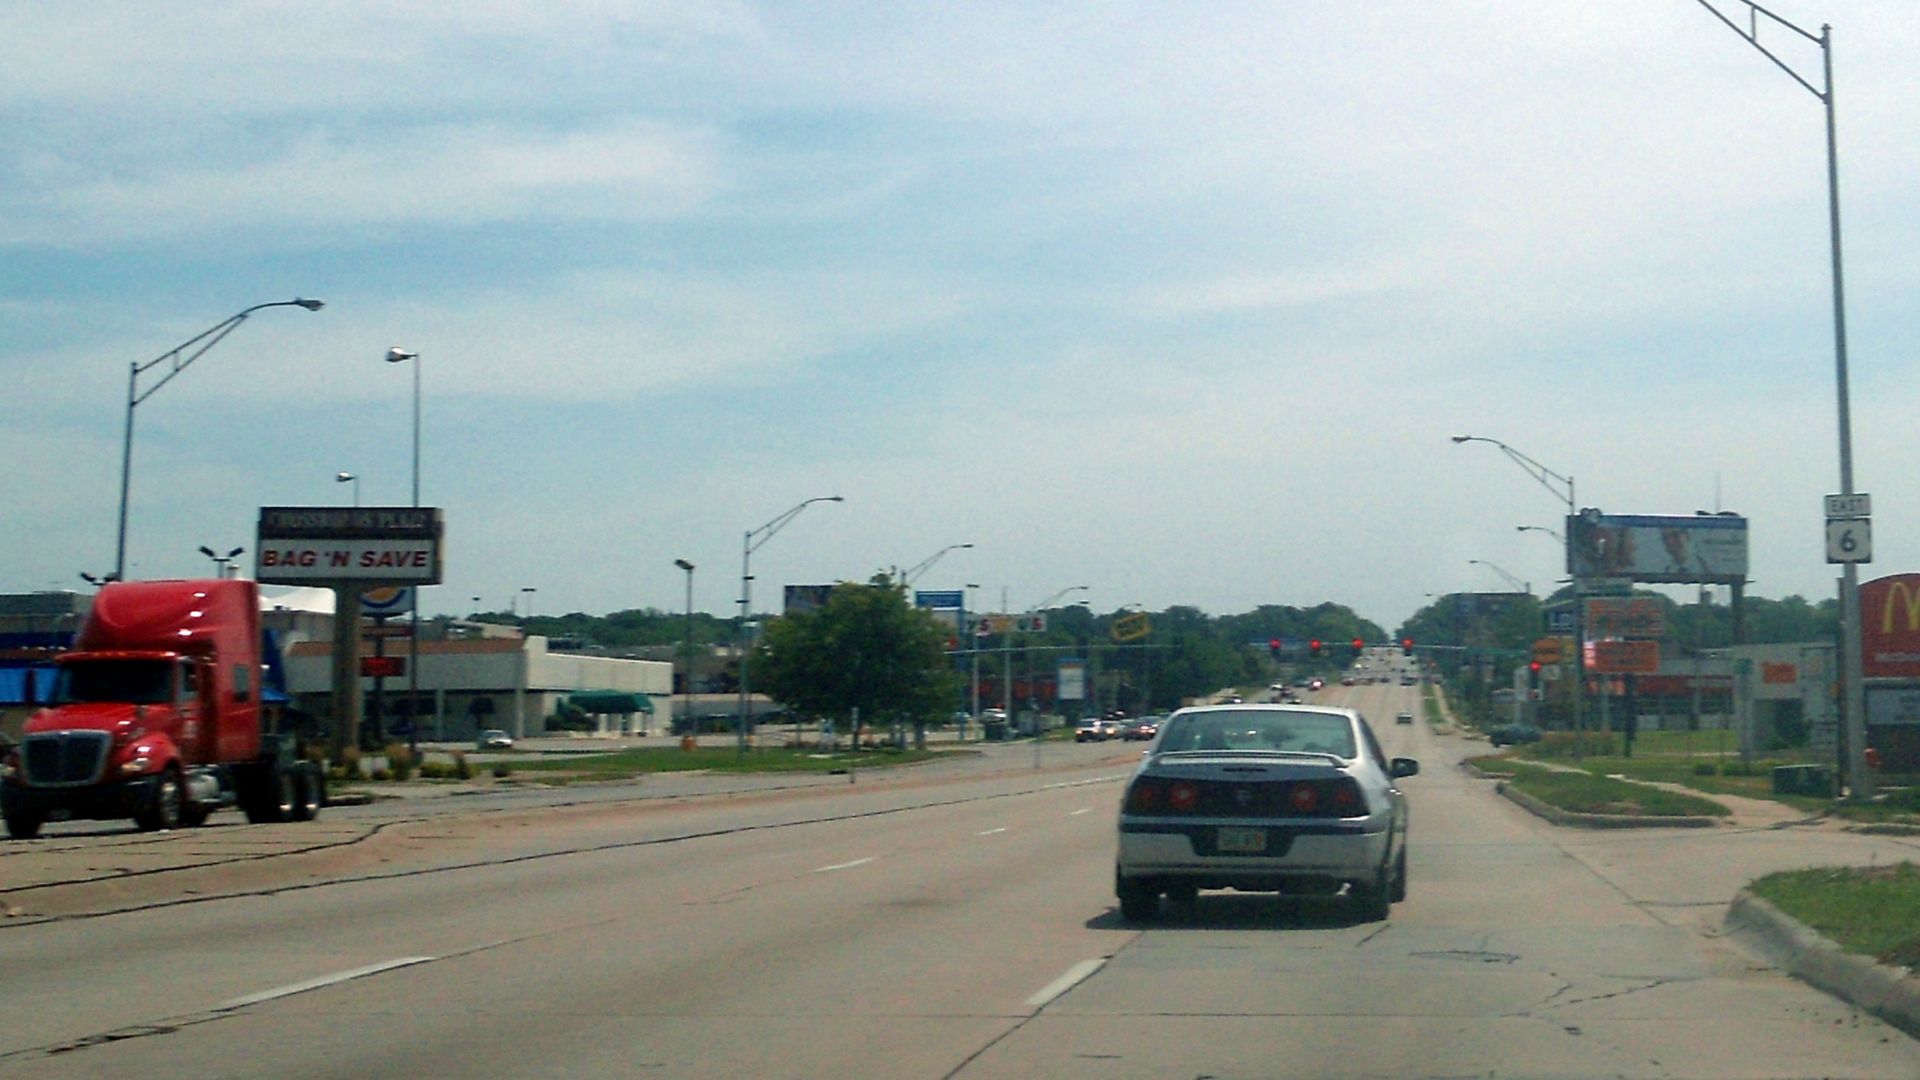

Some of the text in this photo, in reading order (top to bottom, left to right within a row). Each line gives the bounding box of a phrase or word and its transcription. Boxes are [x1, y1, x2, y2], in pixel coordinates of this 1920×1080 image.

[1831, 498, 1863, 512] EAST
[1840, 529, 1856, 552] 6
[262, 551, 429, 567] BAG 'N SAVE
